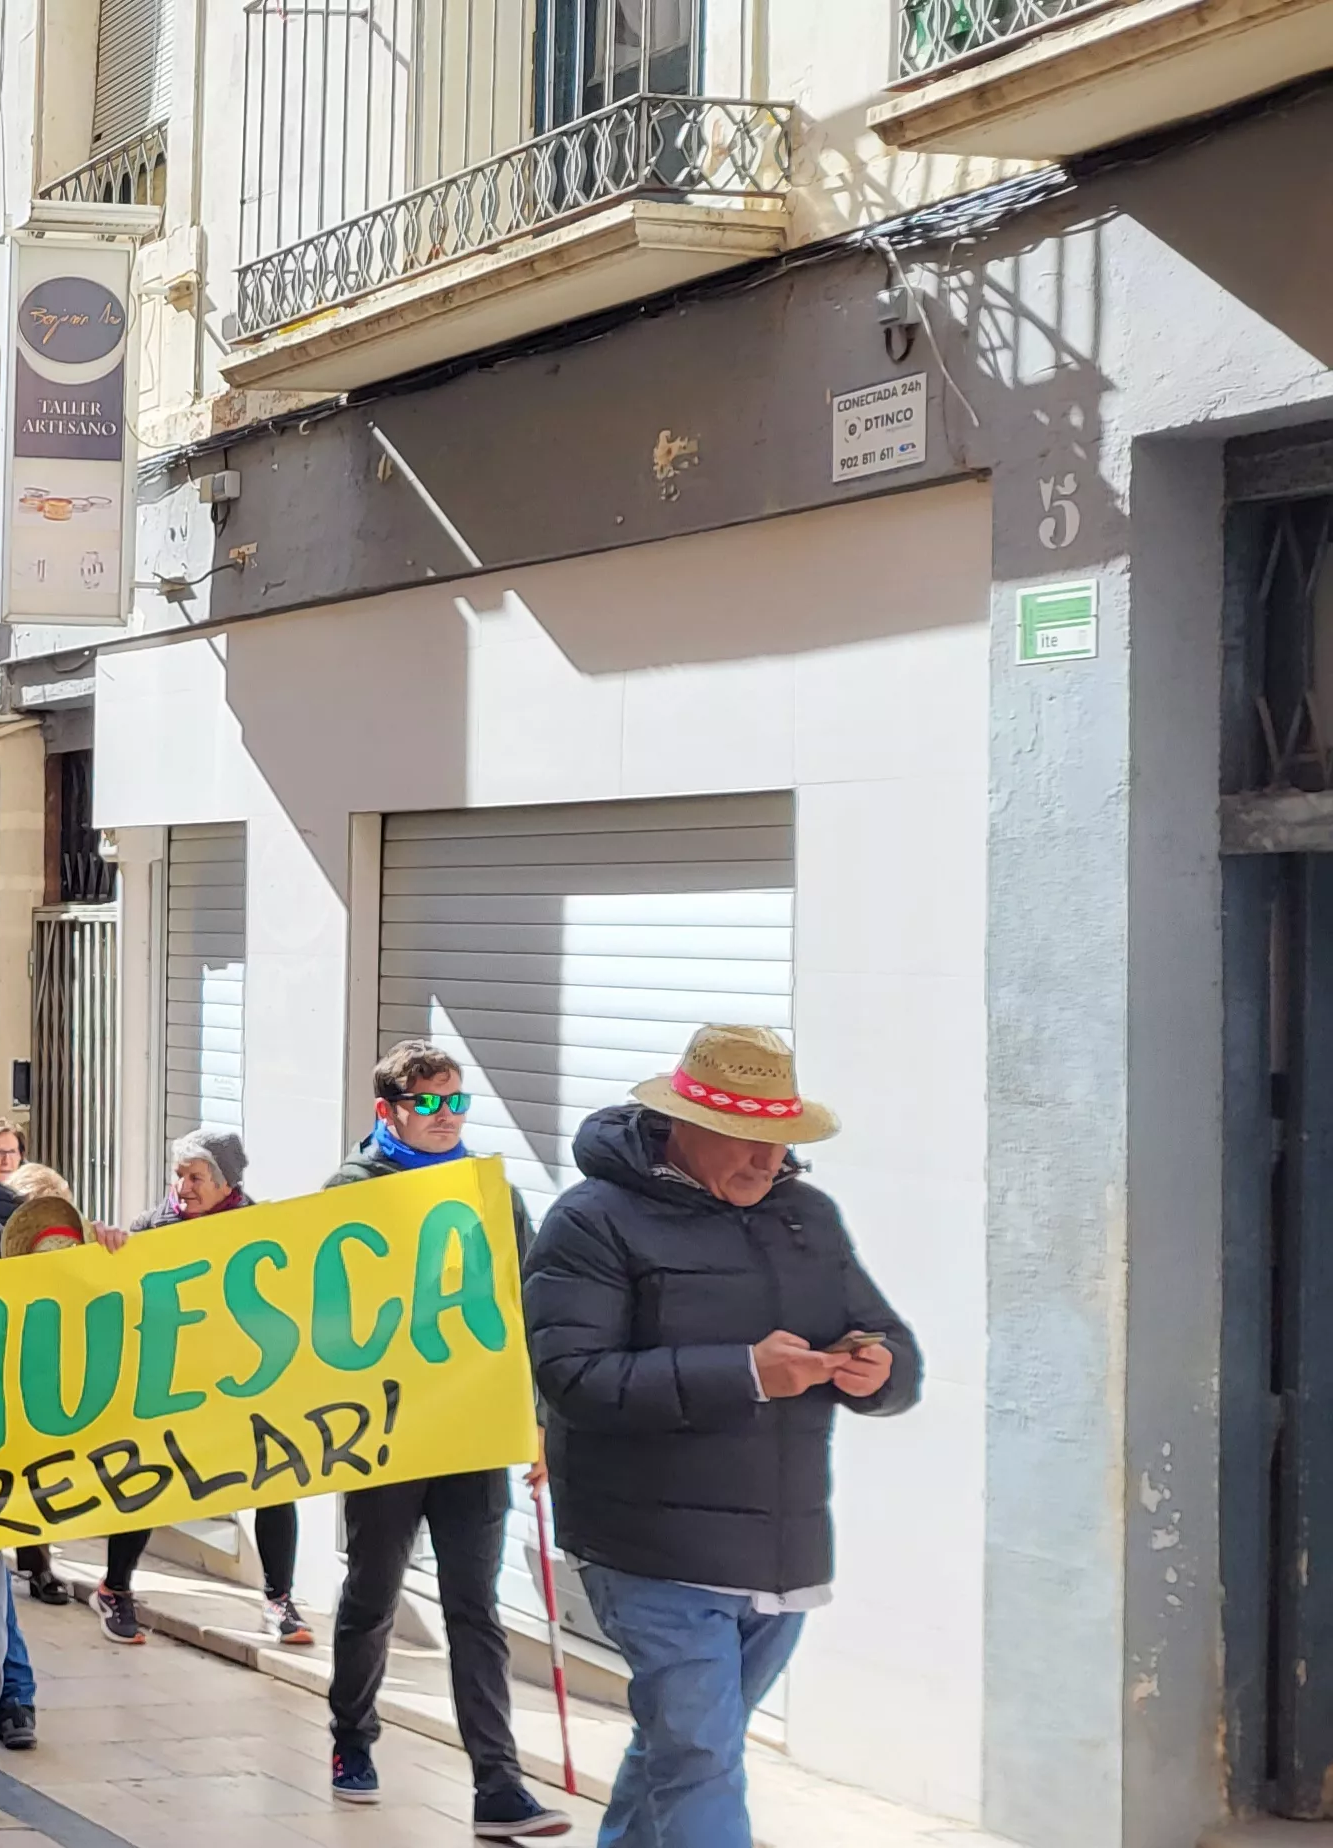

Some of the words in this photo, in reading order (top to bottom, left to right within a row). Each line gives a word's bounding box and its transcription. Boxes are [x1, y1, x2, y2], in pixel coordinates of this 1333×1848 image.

[39, 399, 102, 416] TALLER
[837, 386, 898, 412] CONECTADA
[901, 380, 921, 396] 24h
[22, 419, 117, 436] ARTESANO
[864, 407, 913, 432] DTINCO
[840, 455, 859, 470] 902
[880, 447, 894, 461] 611
[1039, 473, 1081, 549] 5
[1040, 634, 1058, 648] ite
